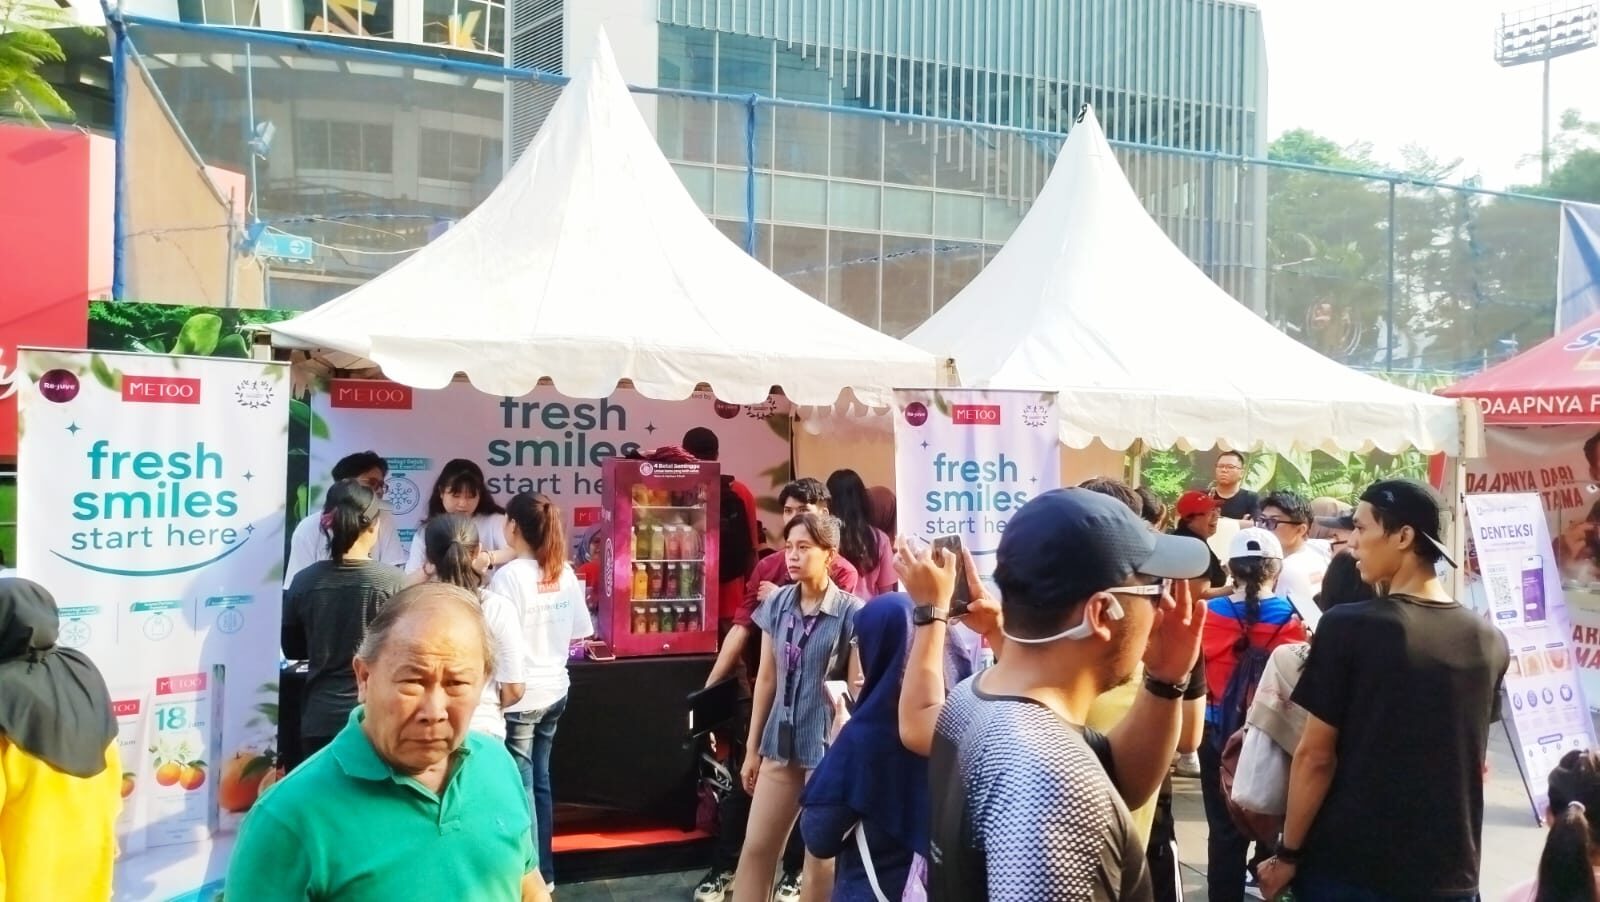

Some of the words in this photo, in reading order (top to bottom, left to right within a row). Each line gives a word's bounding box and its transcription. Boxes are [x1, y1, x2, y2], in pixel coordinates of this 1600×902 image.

[43, 382, 75, 392] Re-juve
[129, 382, 194, 398] METOO
[339, 387, 404, 402] METOO
[499, 396, 626, 431] fresh
[956, 409, 996, 420] METOO
[87, 440, 223, 480] fresh
[933, 452, 1017, 483] fresh
[488, 473, 561, 495] start
[574, 472, 603, 495] he
[1540, 465, 1575, 488] DARI
[72, 481, 239, 521] smiles
[926, 483, 1028, 512] smiles
[926, 516, 976, 534] start
[984, 515, 1009, 534] he
[1480, 523, 1534, 540] DENTEKSI
[71, 525, 153, 550] start
[167, 523, 238, 547] here
[1572, 624, 1600, 645] AR
[160, 678, 202, 691] METOO
[112, 704, 137, 713] TOO
[155, 706, 187, 731] 18
